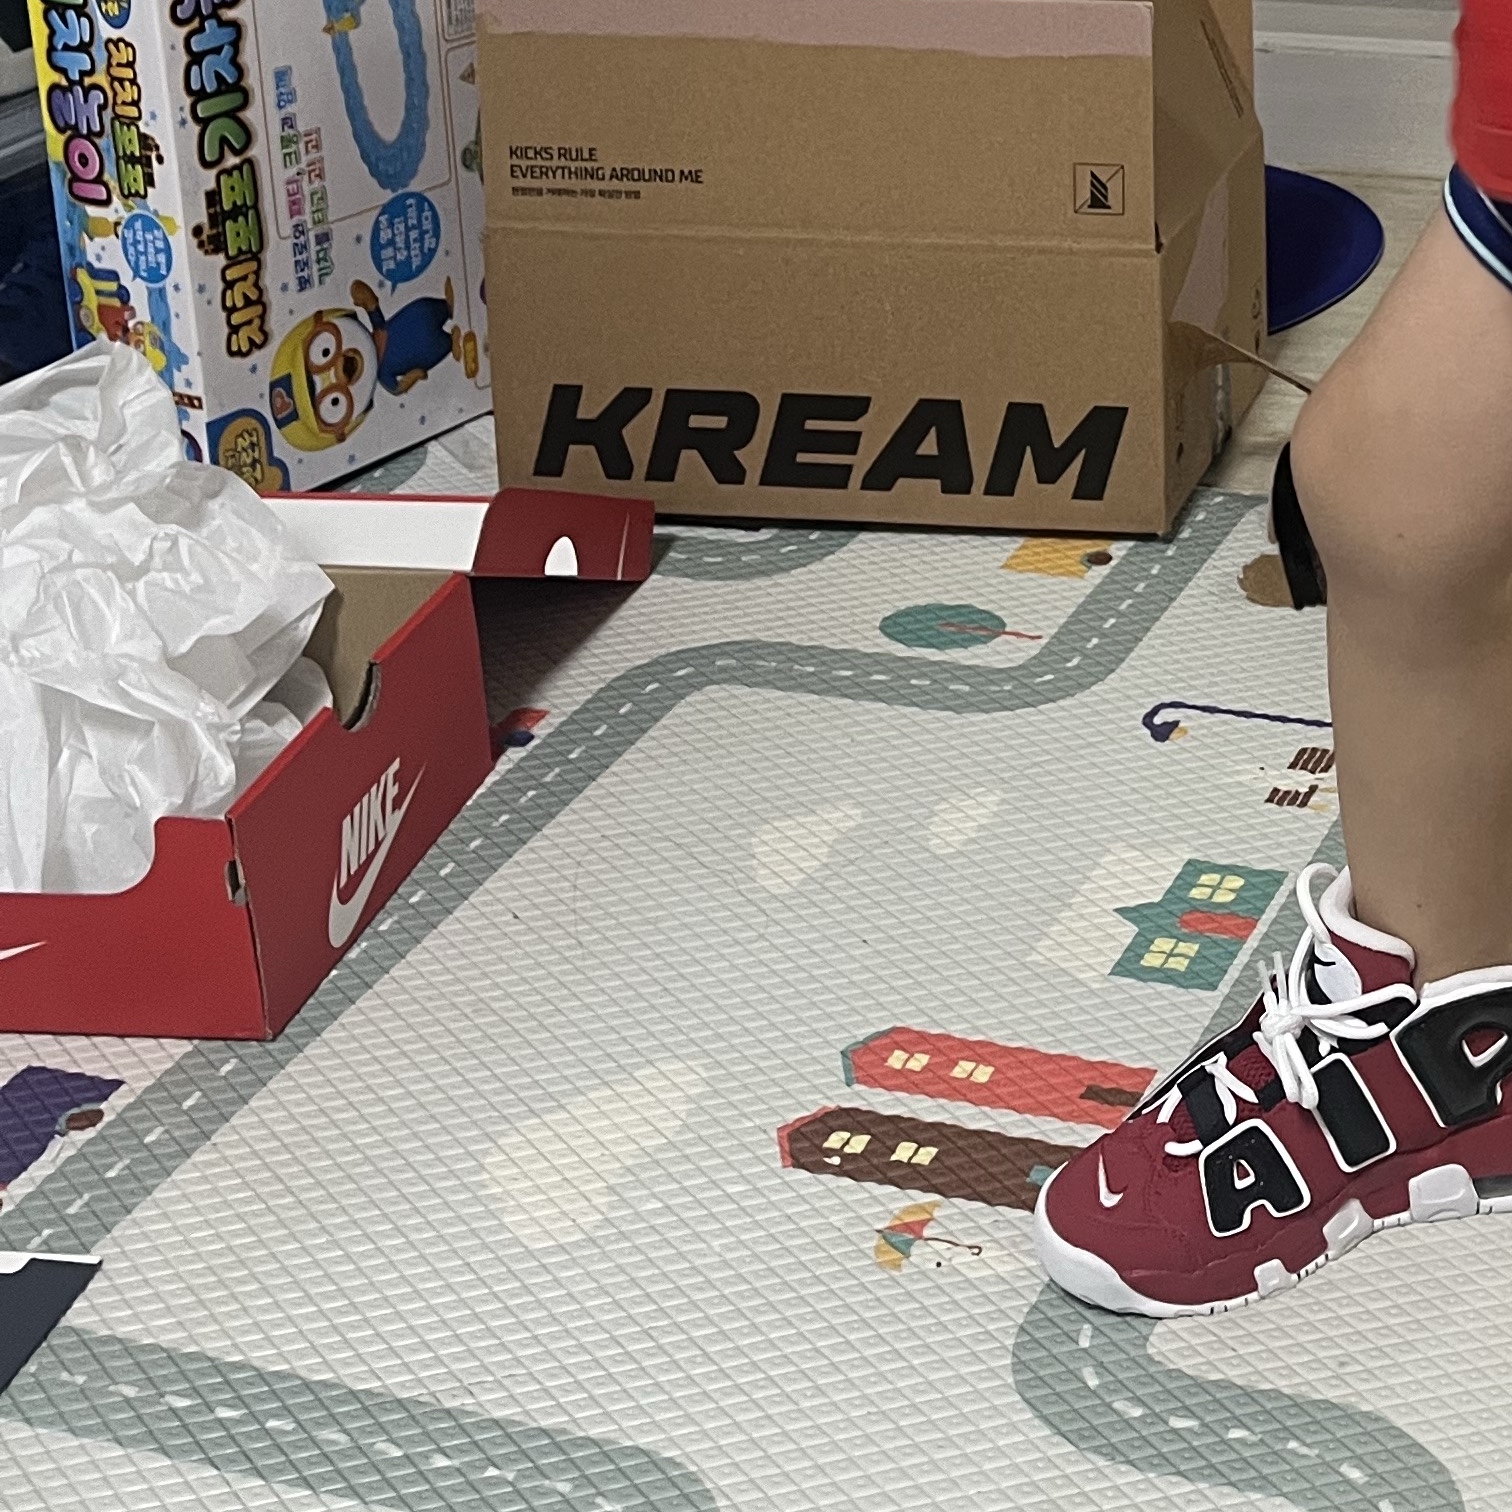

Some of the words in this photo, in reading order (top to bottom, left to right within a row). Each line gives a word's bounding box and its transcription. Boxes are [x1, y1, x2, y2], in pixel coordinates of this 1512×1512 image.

[104, 38, 146, 198] 치치포포
[509, 145, 554, 162] KICKS
[557, 146, 598, 163] RULE
[510, 164, 606, 183] EVERYTHING
[609, 167, 672, 184] AROUND
[675, 168, 704, 185] ME
[218, 160, 271, 357] 치치포포
[533, 384, 1129, 500] KREAM
[339, 756, 403, 890] NIKE
